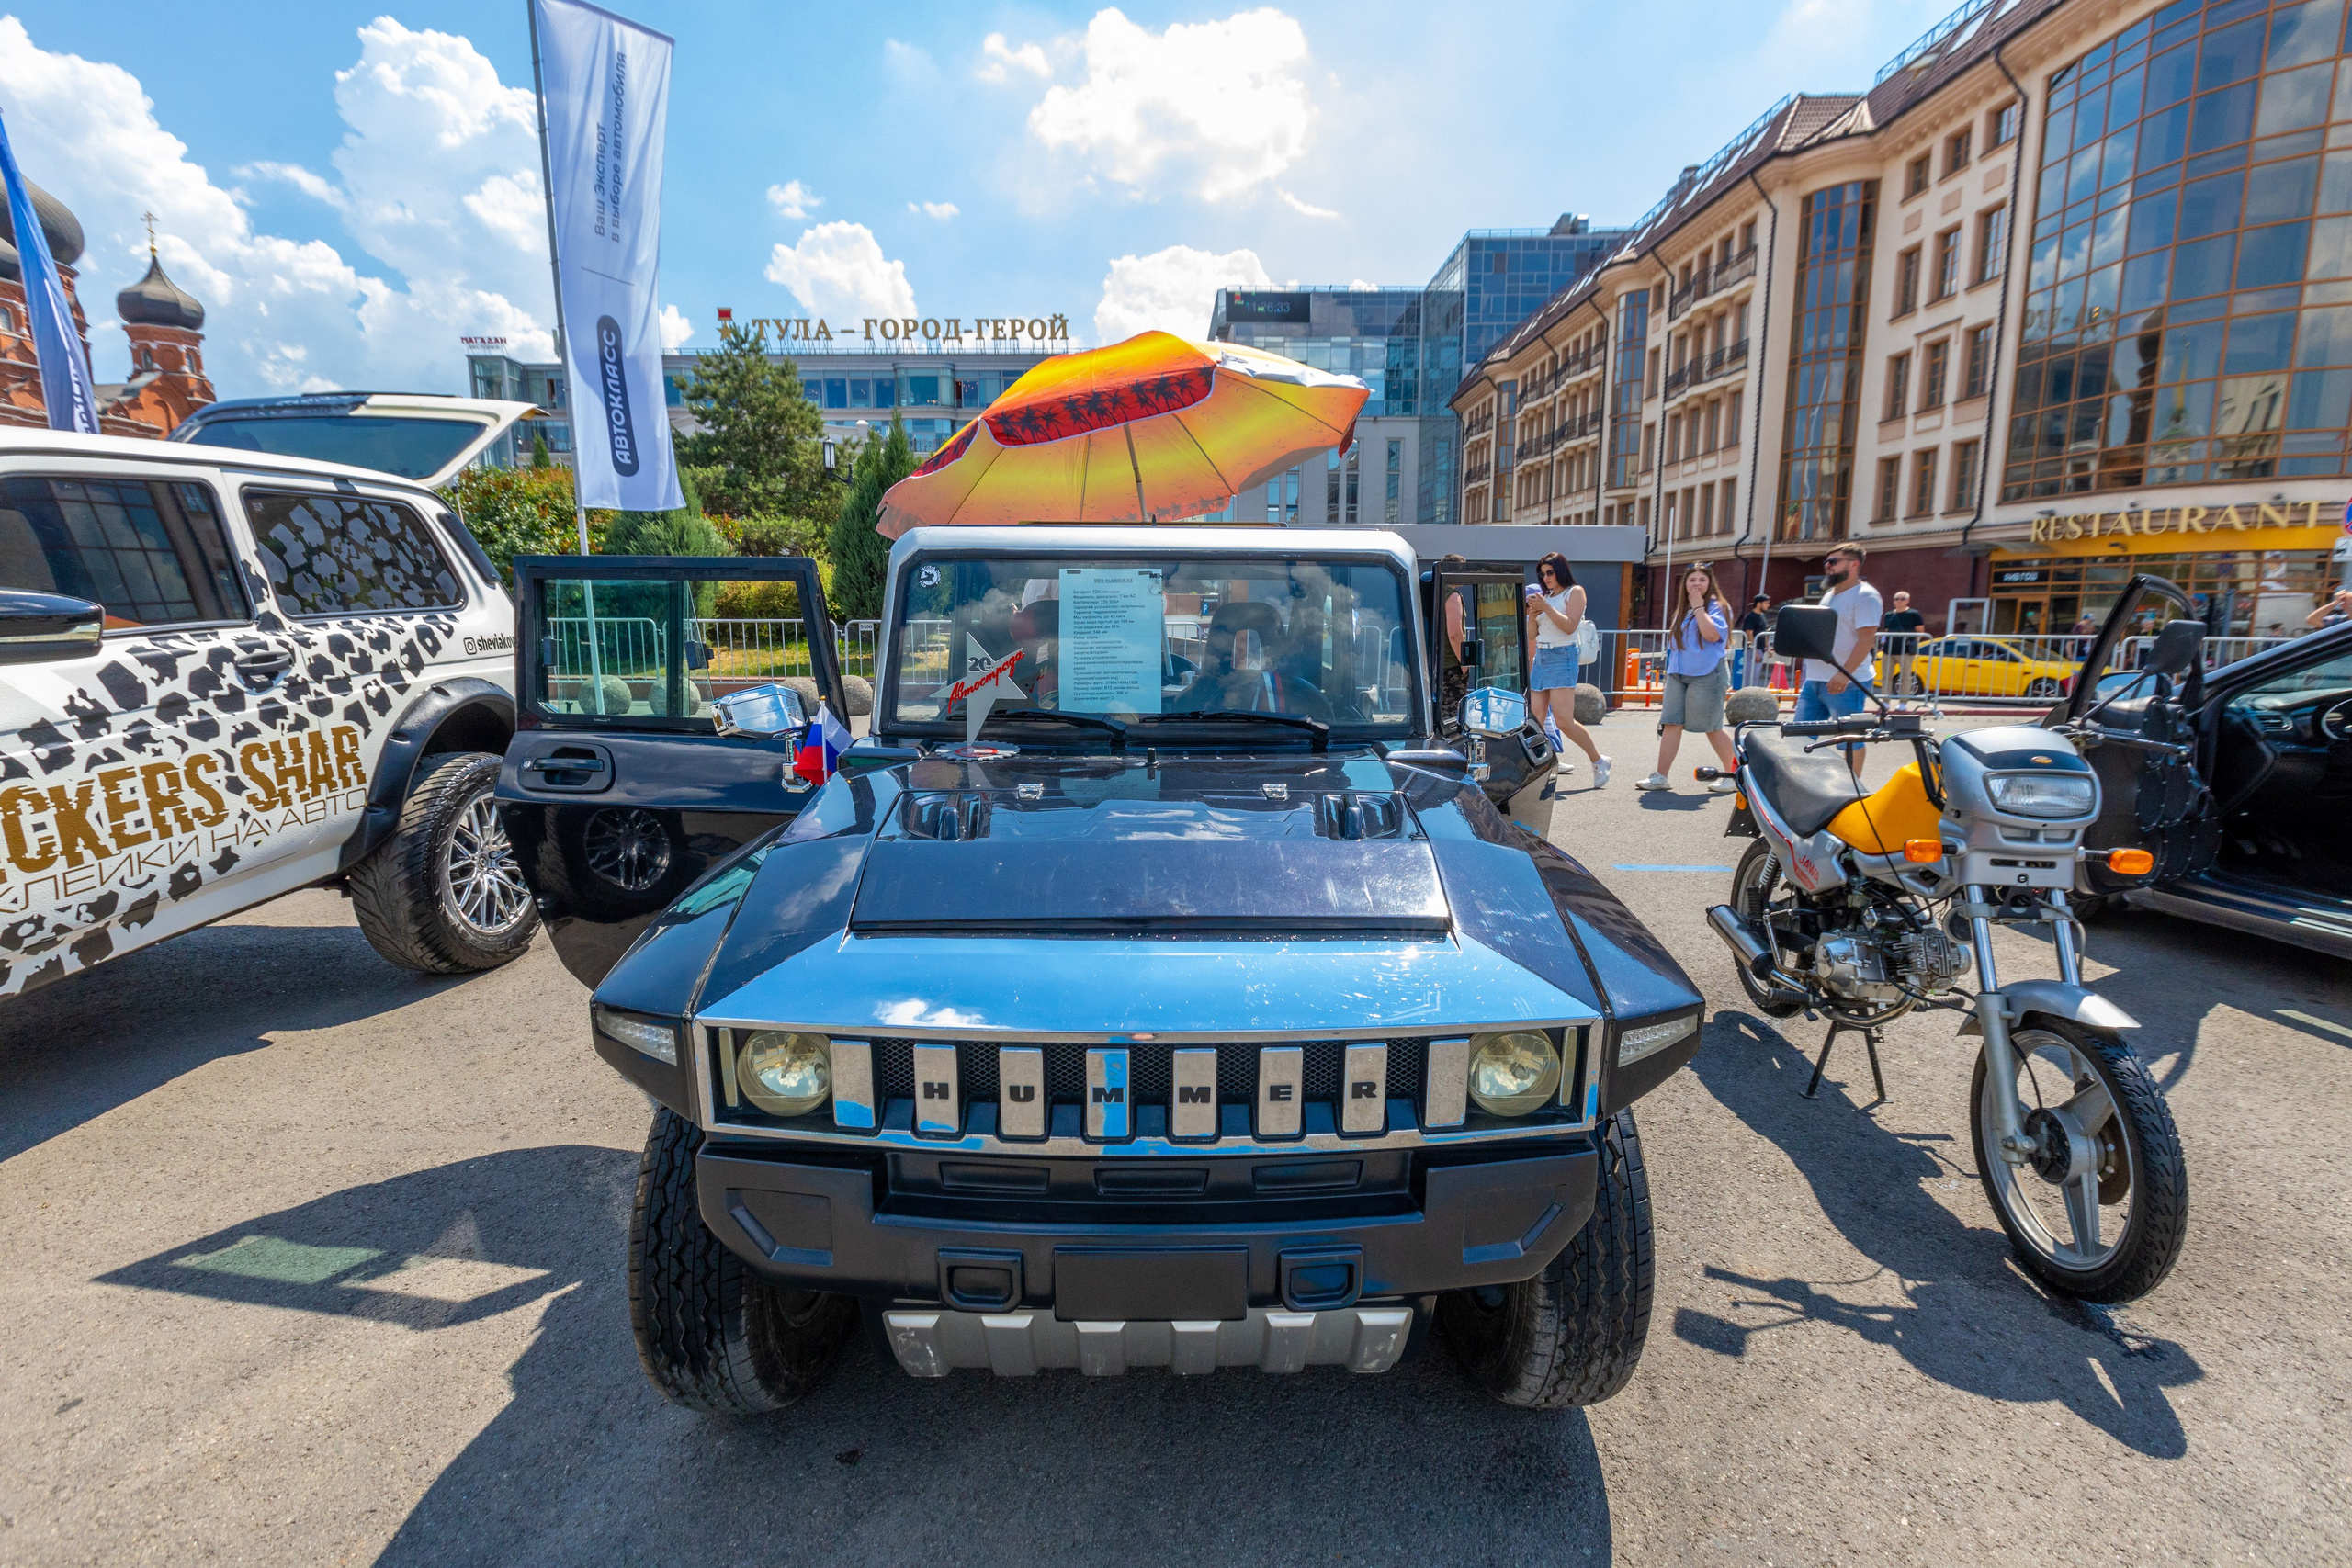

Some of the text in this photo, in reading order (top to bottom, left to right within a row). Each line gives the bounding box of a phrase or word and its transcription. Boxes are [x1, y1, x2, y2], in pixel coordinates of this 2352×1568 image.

[594, 121, 606, 237] Ваш Эксперт
[610, 51, 627, 243] в выборе автомобиля
[460, 336, 508, 344] МАГАДАН
[752, 318, 834, 340] ТУЛА
[863, 313, 1069, 344] ГОРОД-ГЕРОЙ
[602, 329, 632, 465] АВТОКЛАСС
[2030, 500, 2333, 543] RESTAURANT
[947, 650, 1026, 715] Автострада
[0, 725, 368, 885] CKERS SHAR
[211, 818, 271, 852] НА
[277, 787, 368, 833] АВТО
[1798, 854, 1820, 885] JAWA
[922, 1081, 1378, 1104] HUMMER
